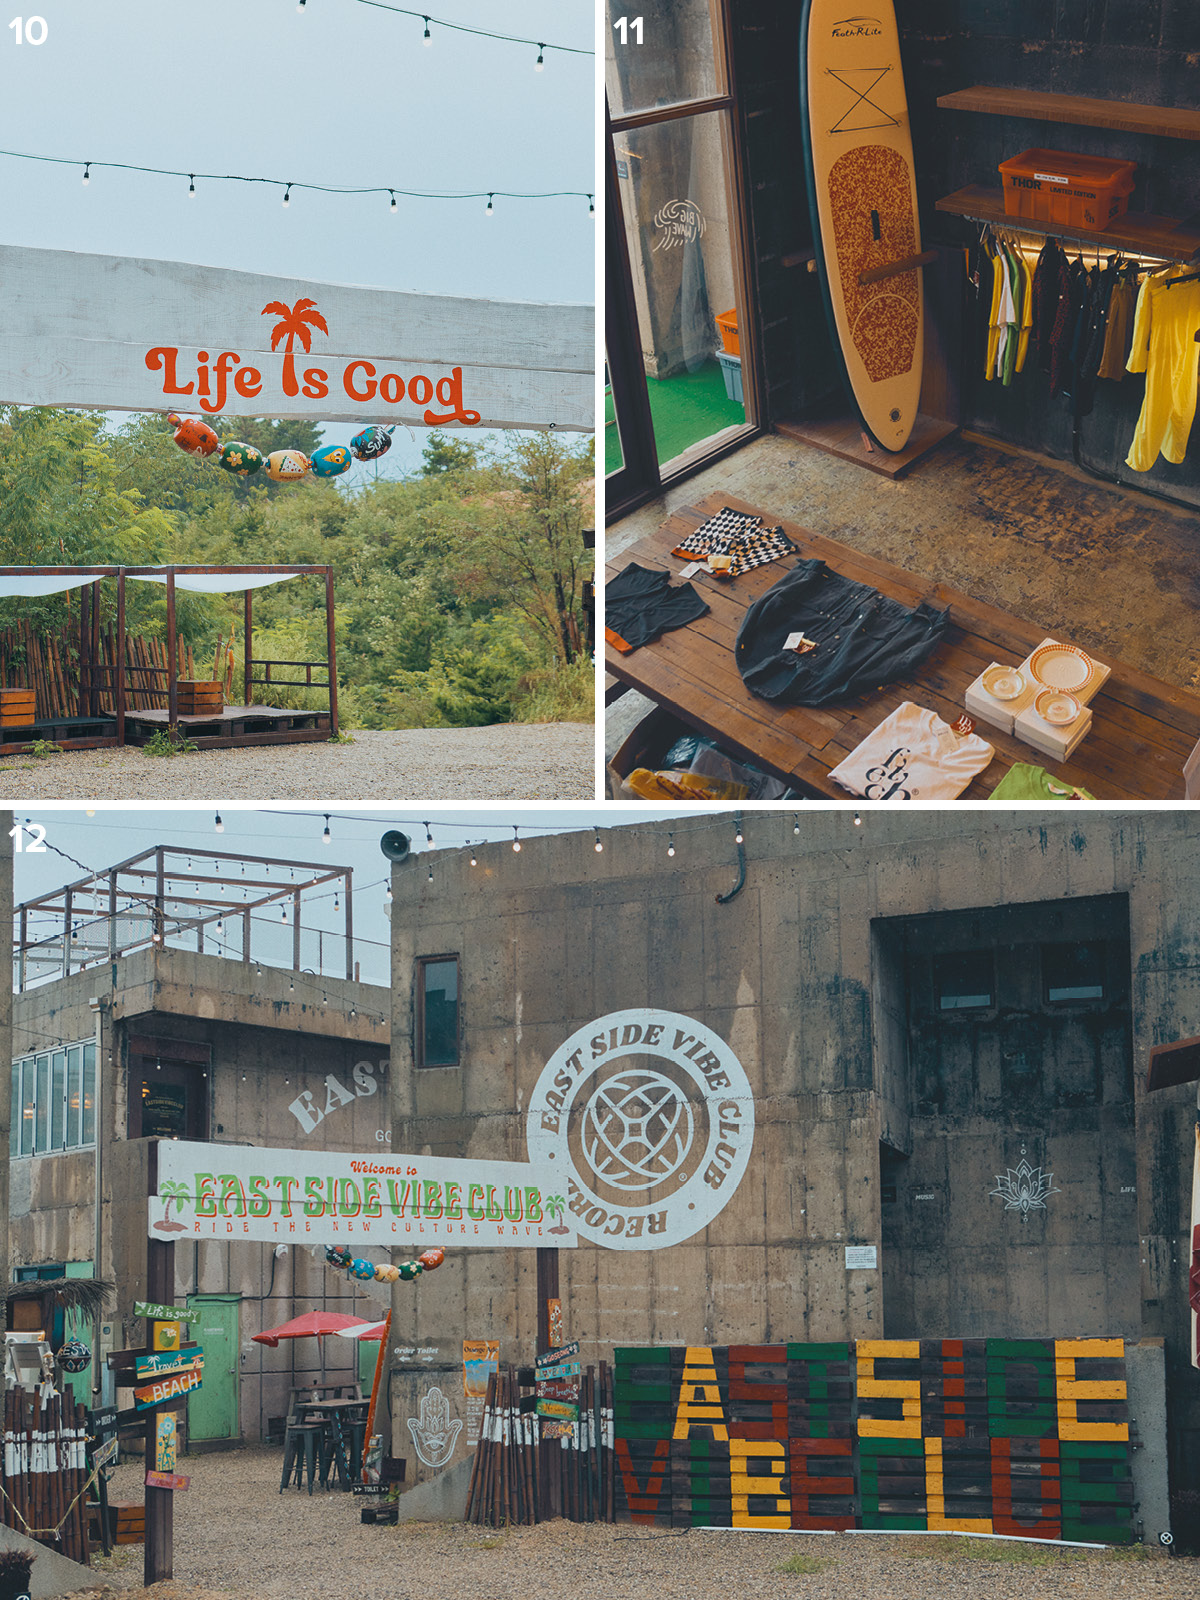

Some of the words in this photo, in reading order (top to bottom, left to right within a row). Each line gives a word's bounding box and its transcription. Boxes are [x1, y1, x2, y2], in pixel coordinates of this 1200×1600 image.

[1010, 176, 1042, 191] THOR
[1049, 186, 1073, 196] LIMITED
[1073, 190, 1097, 200] EDITION
[145, 347, 263, 413] Life
[343, 360, 481, 426] Good
[540, 1047, 585, 1136] EAST
[590, 1023, 665, 1060] SIDE
[671, 1028, 732, 1092] VIBE
[702, 1100, 742, 1190] CLUB
[350, 1160, 402, 1176] Welcome
[406, 1165, 418, 1176] to
[194, 1172, 300, 1218] EAST
[303, 1176, 382, 1218] SIDE
[386, 1178, 463, 1220] VIBE
[467, 1183, 544, 1223] CLUB
[915, 1193, 935, 1201] MUSIC
[194, 1222, 249, 1233] RIDE
[273, 1221, 312, 1232] THE
[332, 1222, 371, 1233] NEW
[391, 1222, 479, 1235] CULTURE
[497, 1225, 544, 1236] WAVE
[146, 1305, 164, 1318] Life
[165, 1308, 173, 1318] is
[173, 1309, 192, 1320] good
[152, 1371, 199, 1403] BEACH
[613, 1342, 850, 1441] EAST
[856, 1338, 1129, 1442] SIDE
[614, 1437, 856, 1530] VIBE
[859, 1437, 1133, 1544] CLUB
